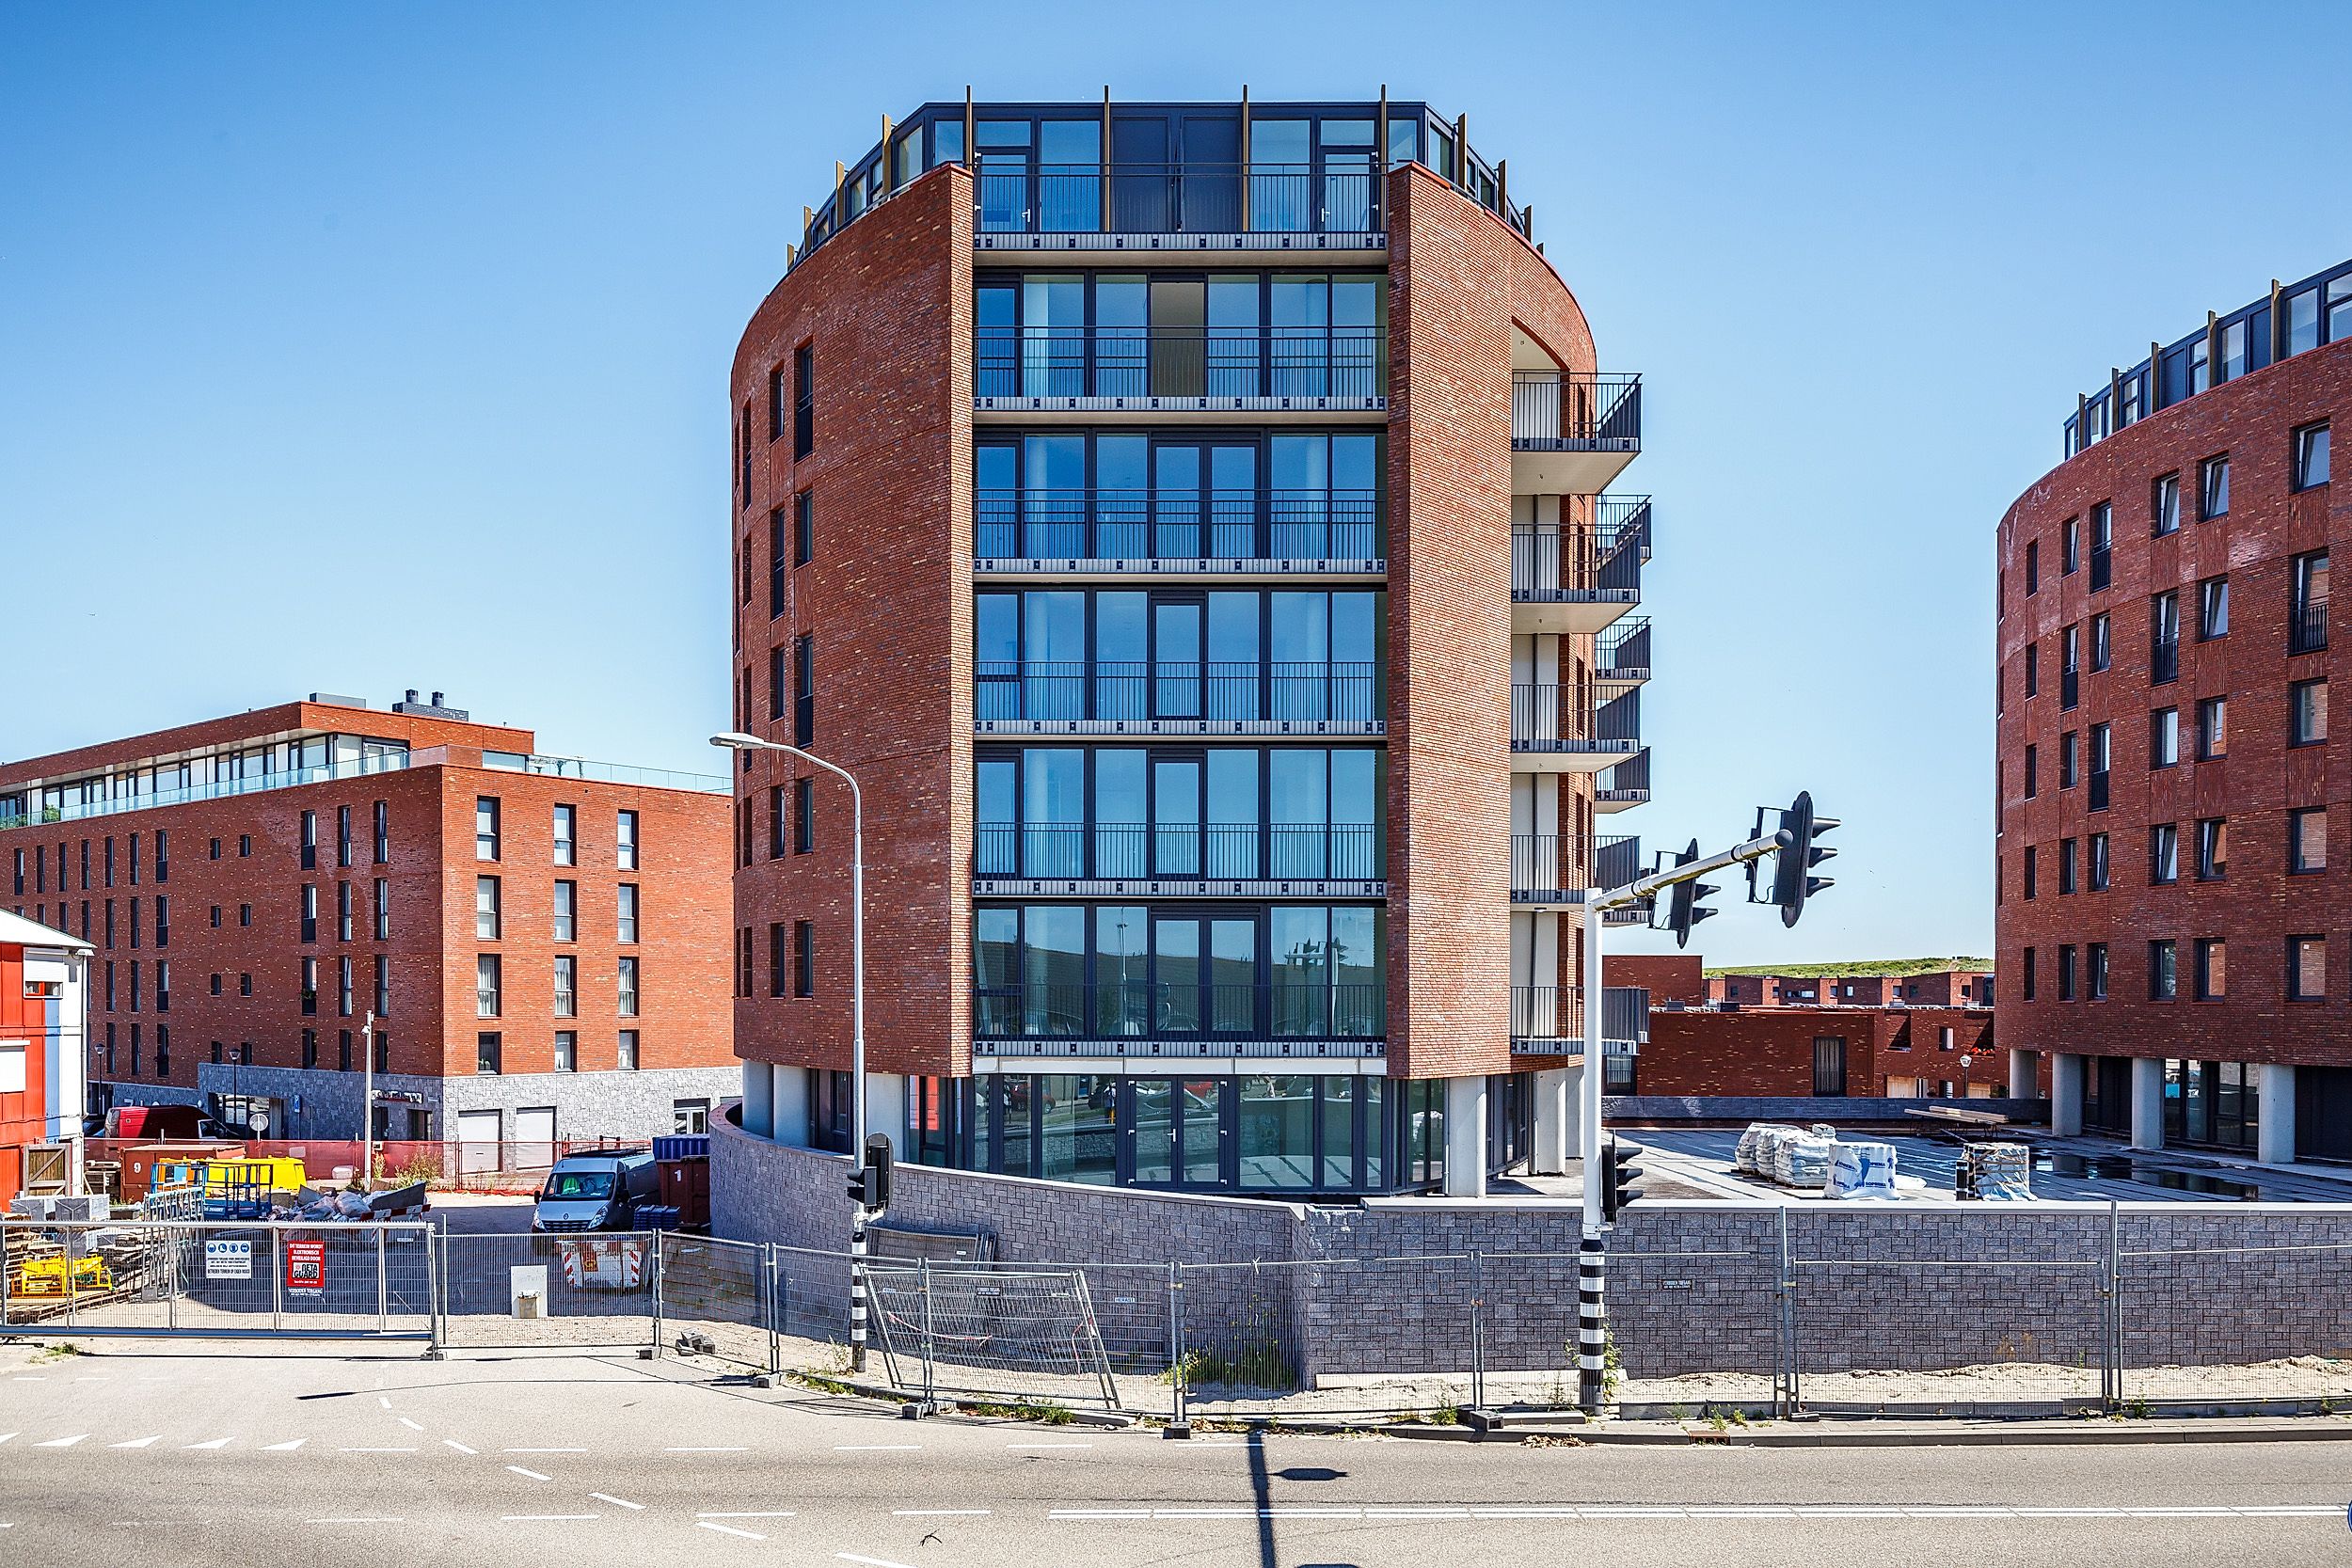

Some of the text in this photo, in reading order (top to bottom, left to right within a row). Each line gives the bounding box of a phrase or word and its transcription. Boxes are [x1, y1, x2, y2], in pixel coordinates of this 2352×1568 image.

[134, 1162, 141, 1173] 9
[674, 1169, 681, 1181] 1
[294, 1270, 318, 1278] GUARD
